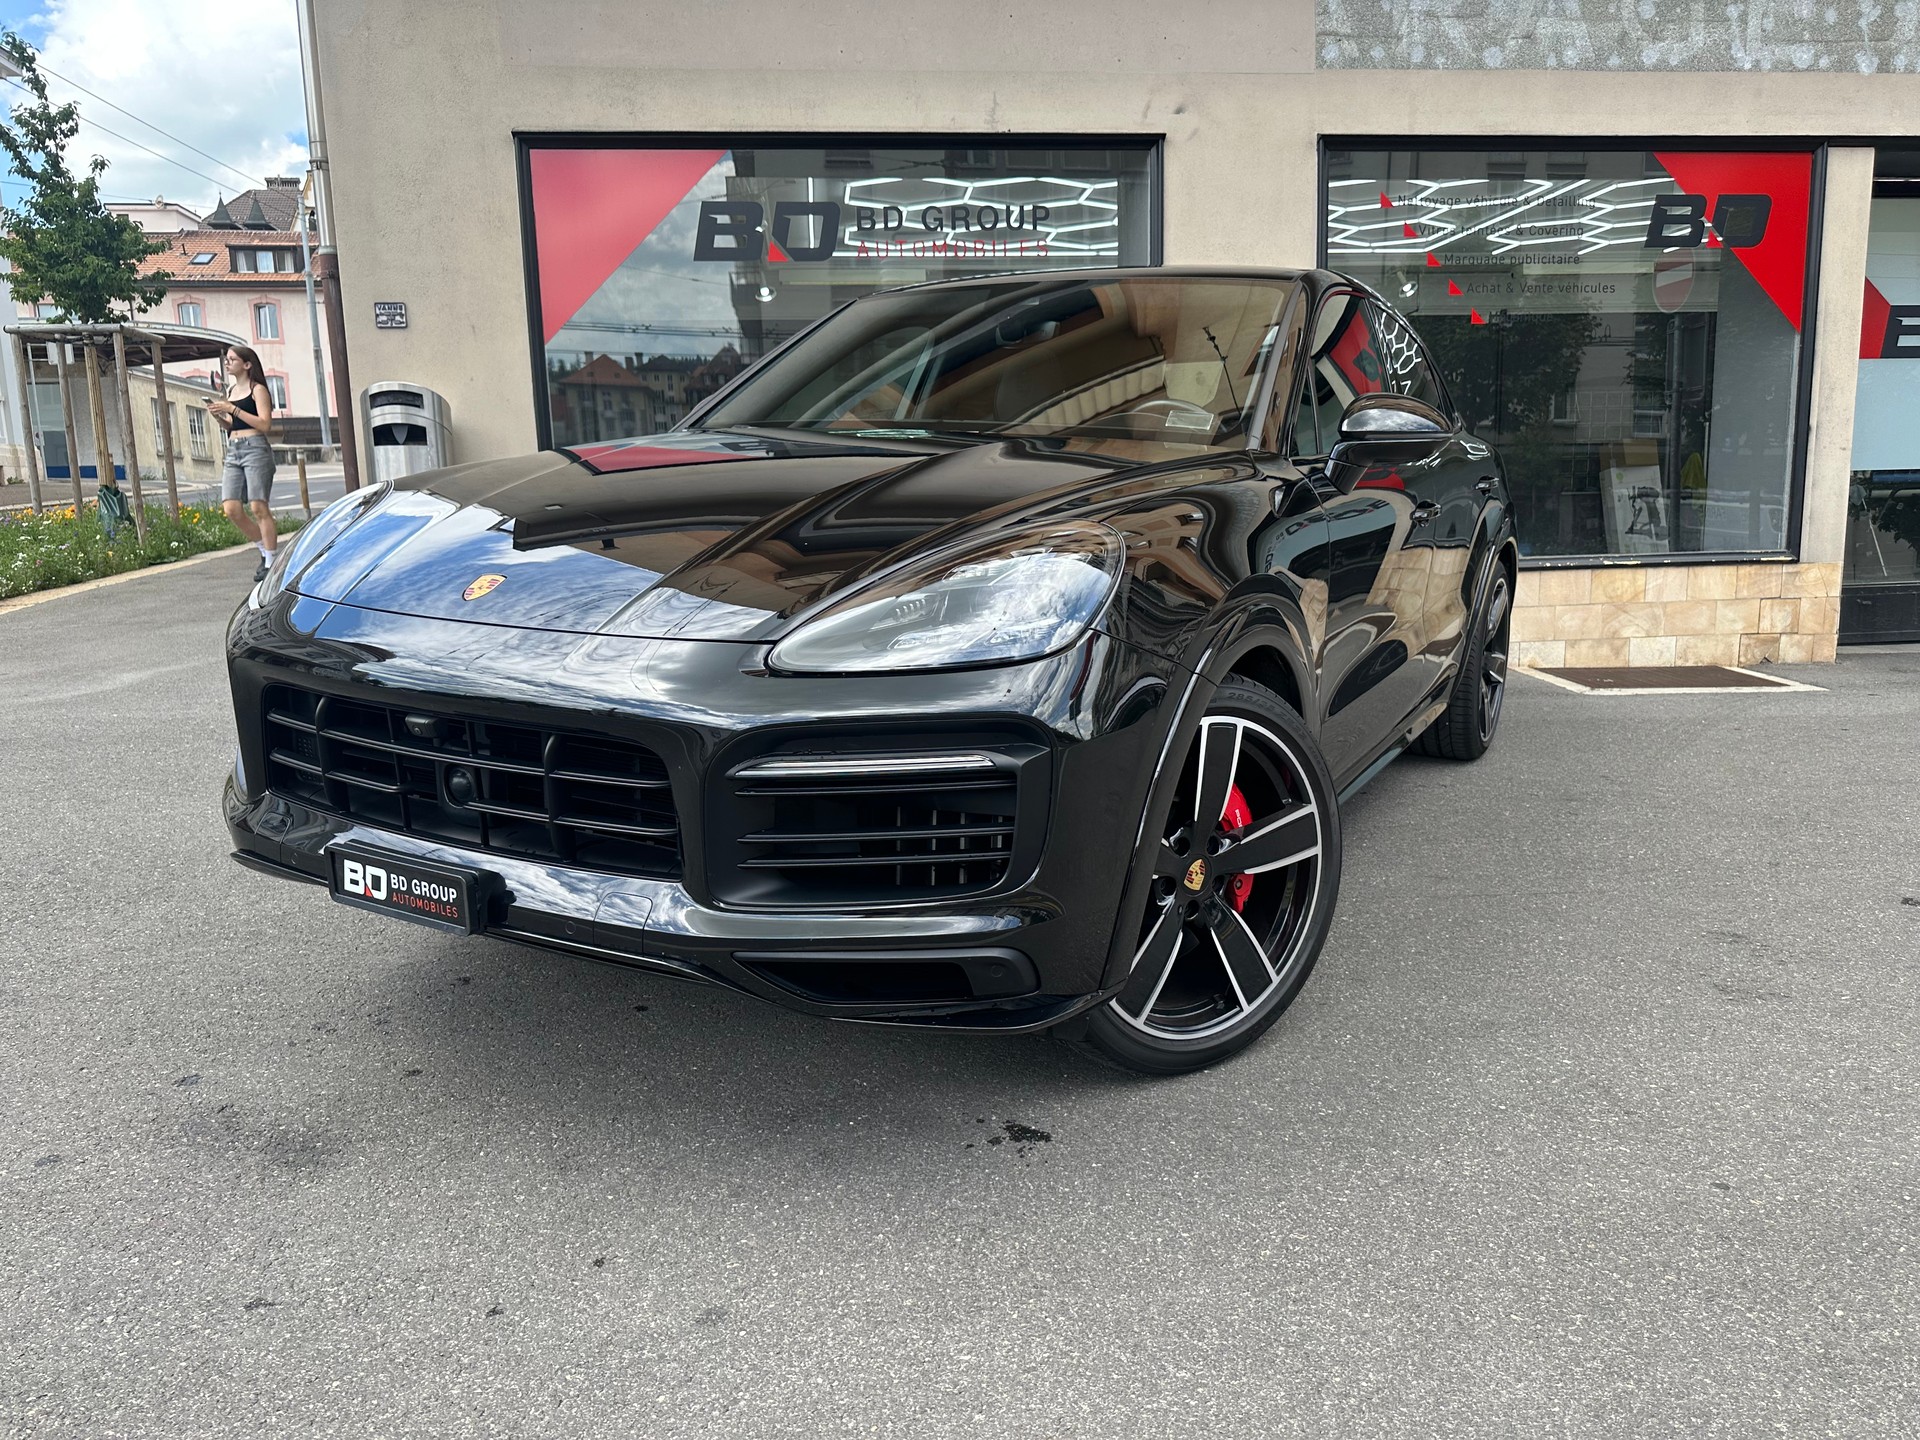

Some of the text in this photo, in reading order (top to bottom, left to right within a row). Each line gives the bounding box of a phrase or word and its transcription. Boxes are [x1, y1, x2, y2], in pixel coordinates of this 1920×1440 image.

[1523, 195, 1530, 206] &
[694, 201, 841, 262] BD
[856, 205, 1051, 232] BD GROUP
[1516, 223, 1523, 236] &
[1529, 224, 1584, 238] Covering
[1644, 194, 1772, 248] BD
[857, 240, 1049, 259] AUTOMOBILES
[1444, 253, 1580, 267] Marquage publicitaire
[1467, 281, 1616, 294] Achat & Vente véhicules
[344, 859, 387, 900] BD
[390, 874, 457, 903] BD GROUP
[392, 892, 458, 918] AUTOMOBILES
